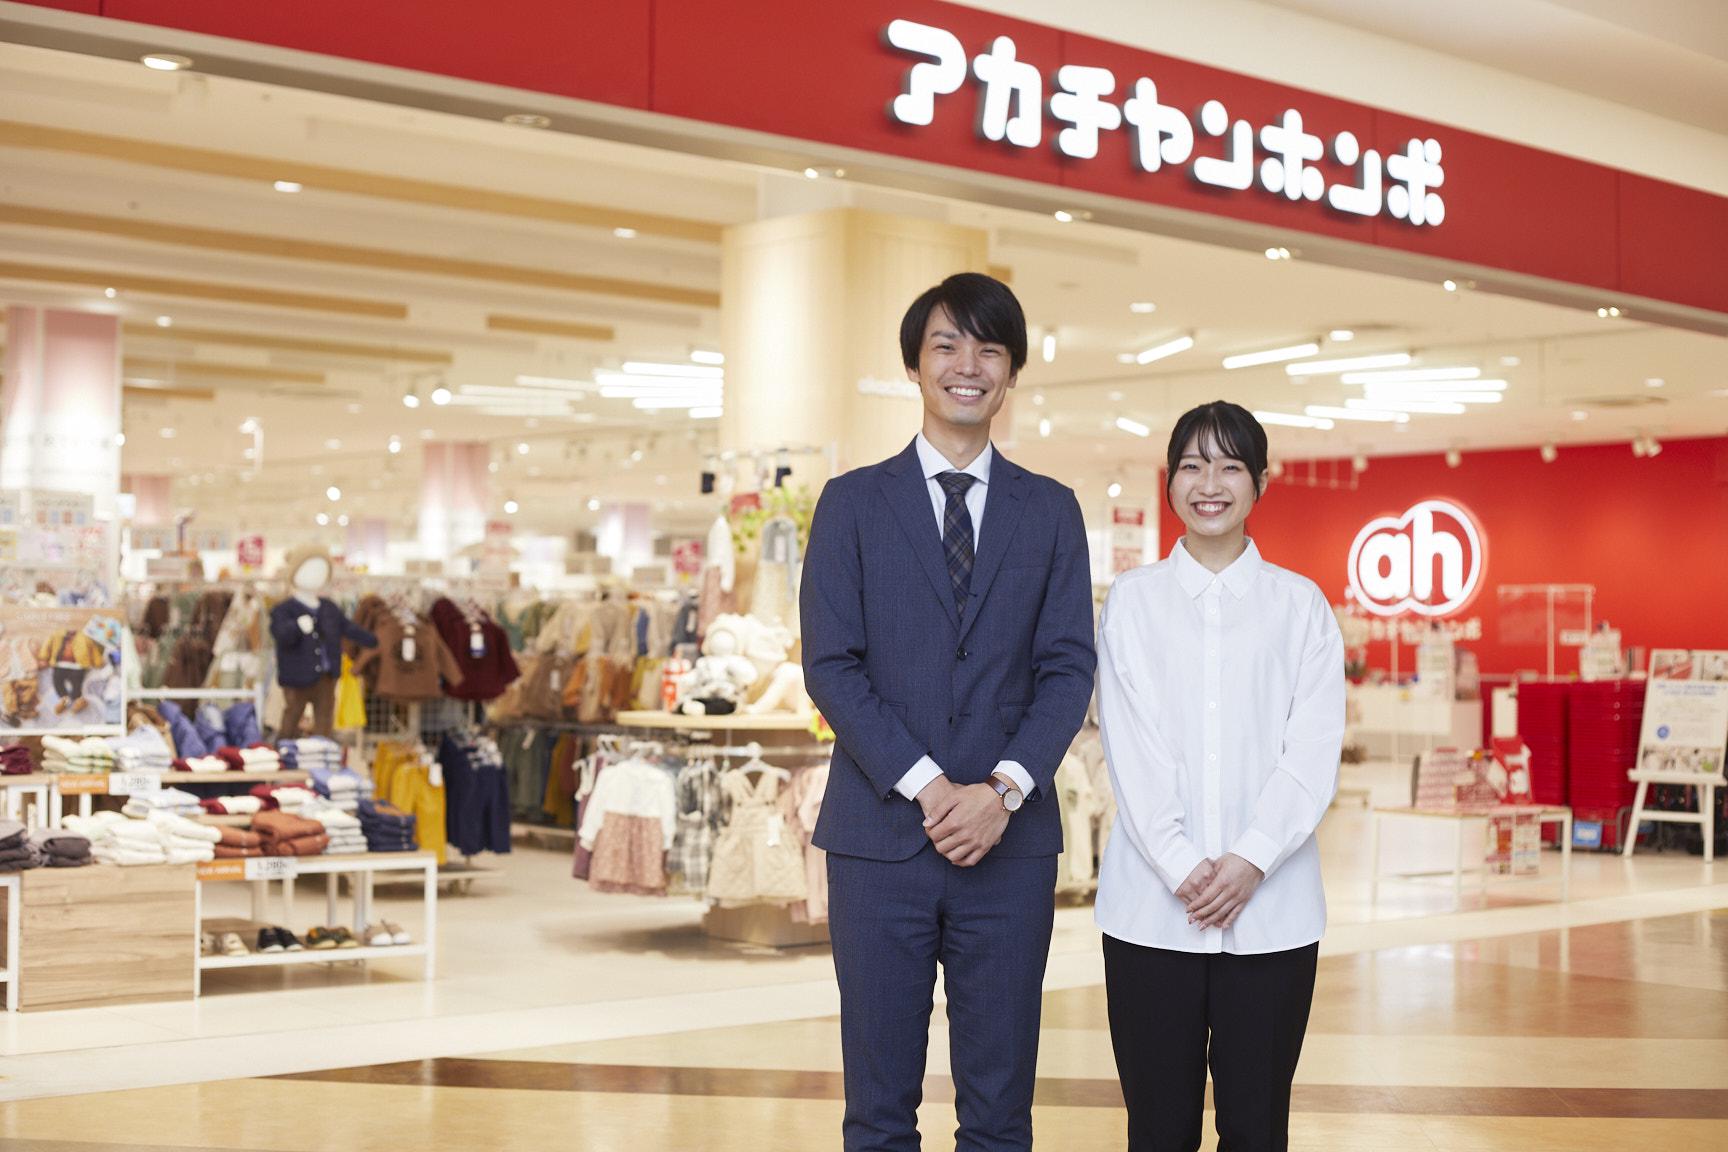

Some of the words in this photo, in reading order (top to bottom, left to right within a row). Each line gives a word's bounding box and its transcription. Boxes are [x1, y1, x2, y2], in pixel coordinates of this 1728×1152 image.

[887, 19, 1445, 226] アカチャンホンポ
[1359, 506, 1463, 600] ah
